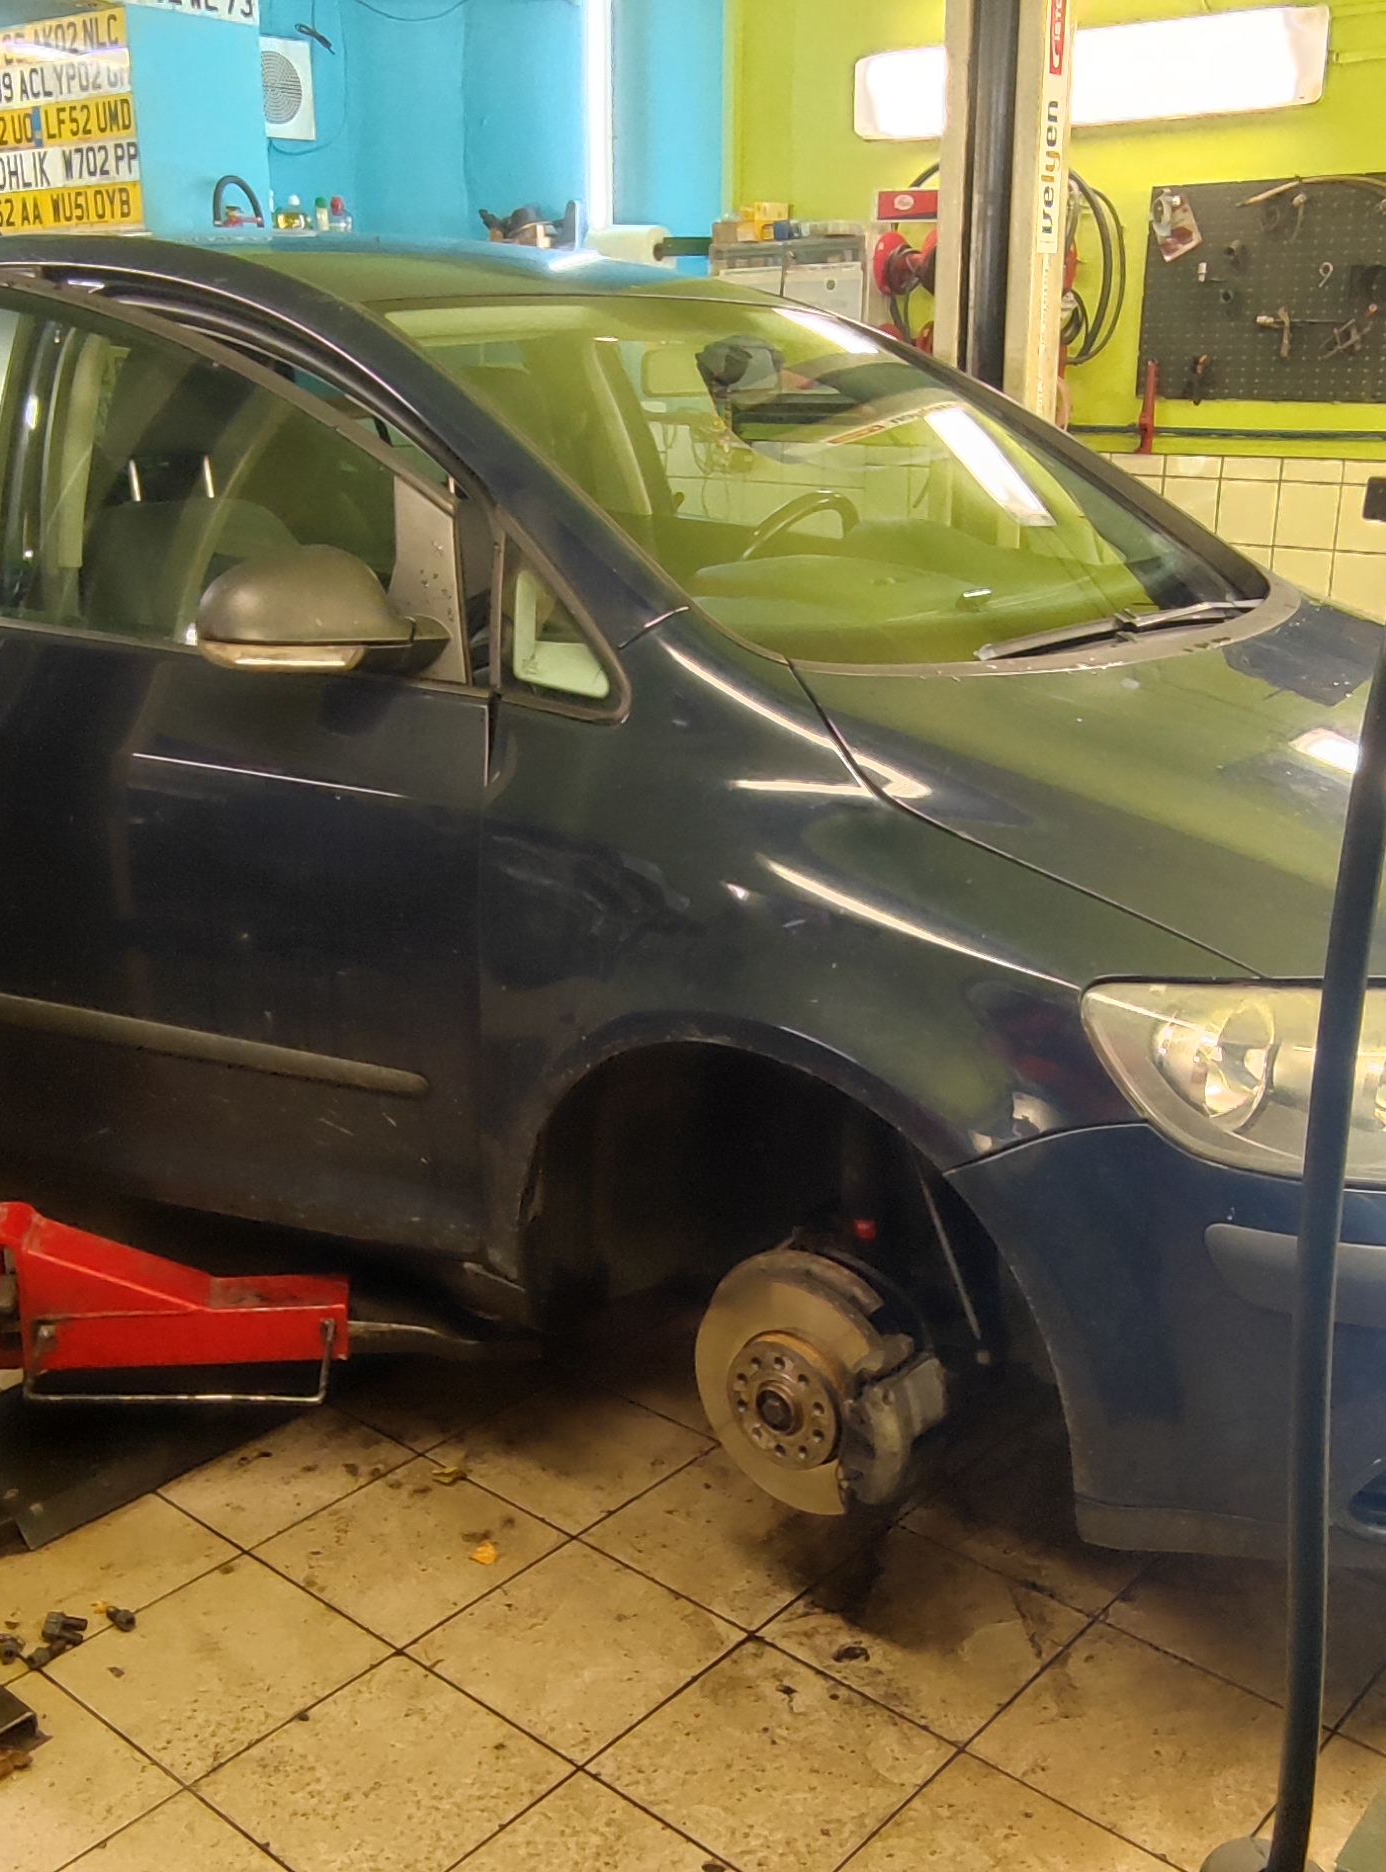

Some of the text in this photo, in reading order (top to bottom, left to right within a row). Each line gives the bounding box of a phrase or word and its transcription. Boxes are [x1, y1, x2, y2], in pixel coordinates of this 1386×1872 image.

[83, 14, 119, 50] NLC
[20, 68, 53, 101] ACL
[53, 60, 101, 96] YP02
[44, 98, 132, 140] LF52 UMD
[62, 142, 138, 181] W702 PP
[1041, 100, 1061, 235] velyen
[20, 196, 44, 227] AA
[50, 187, 131, 223] WU51 OYB
